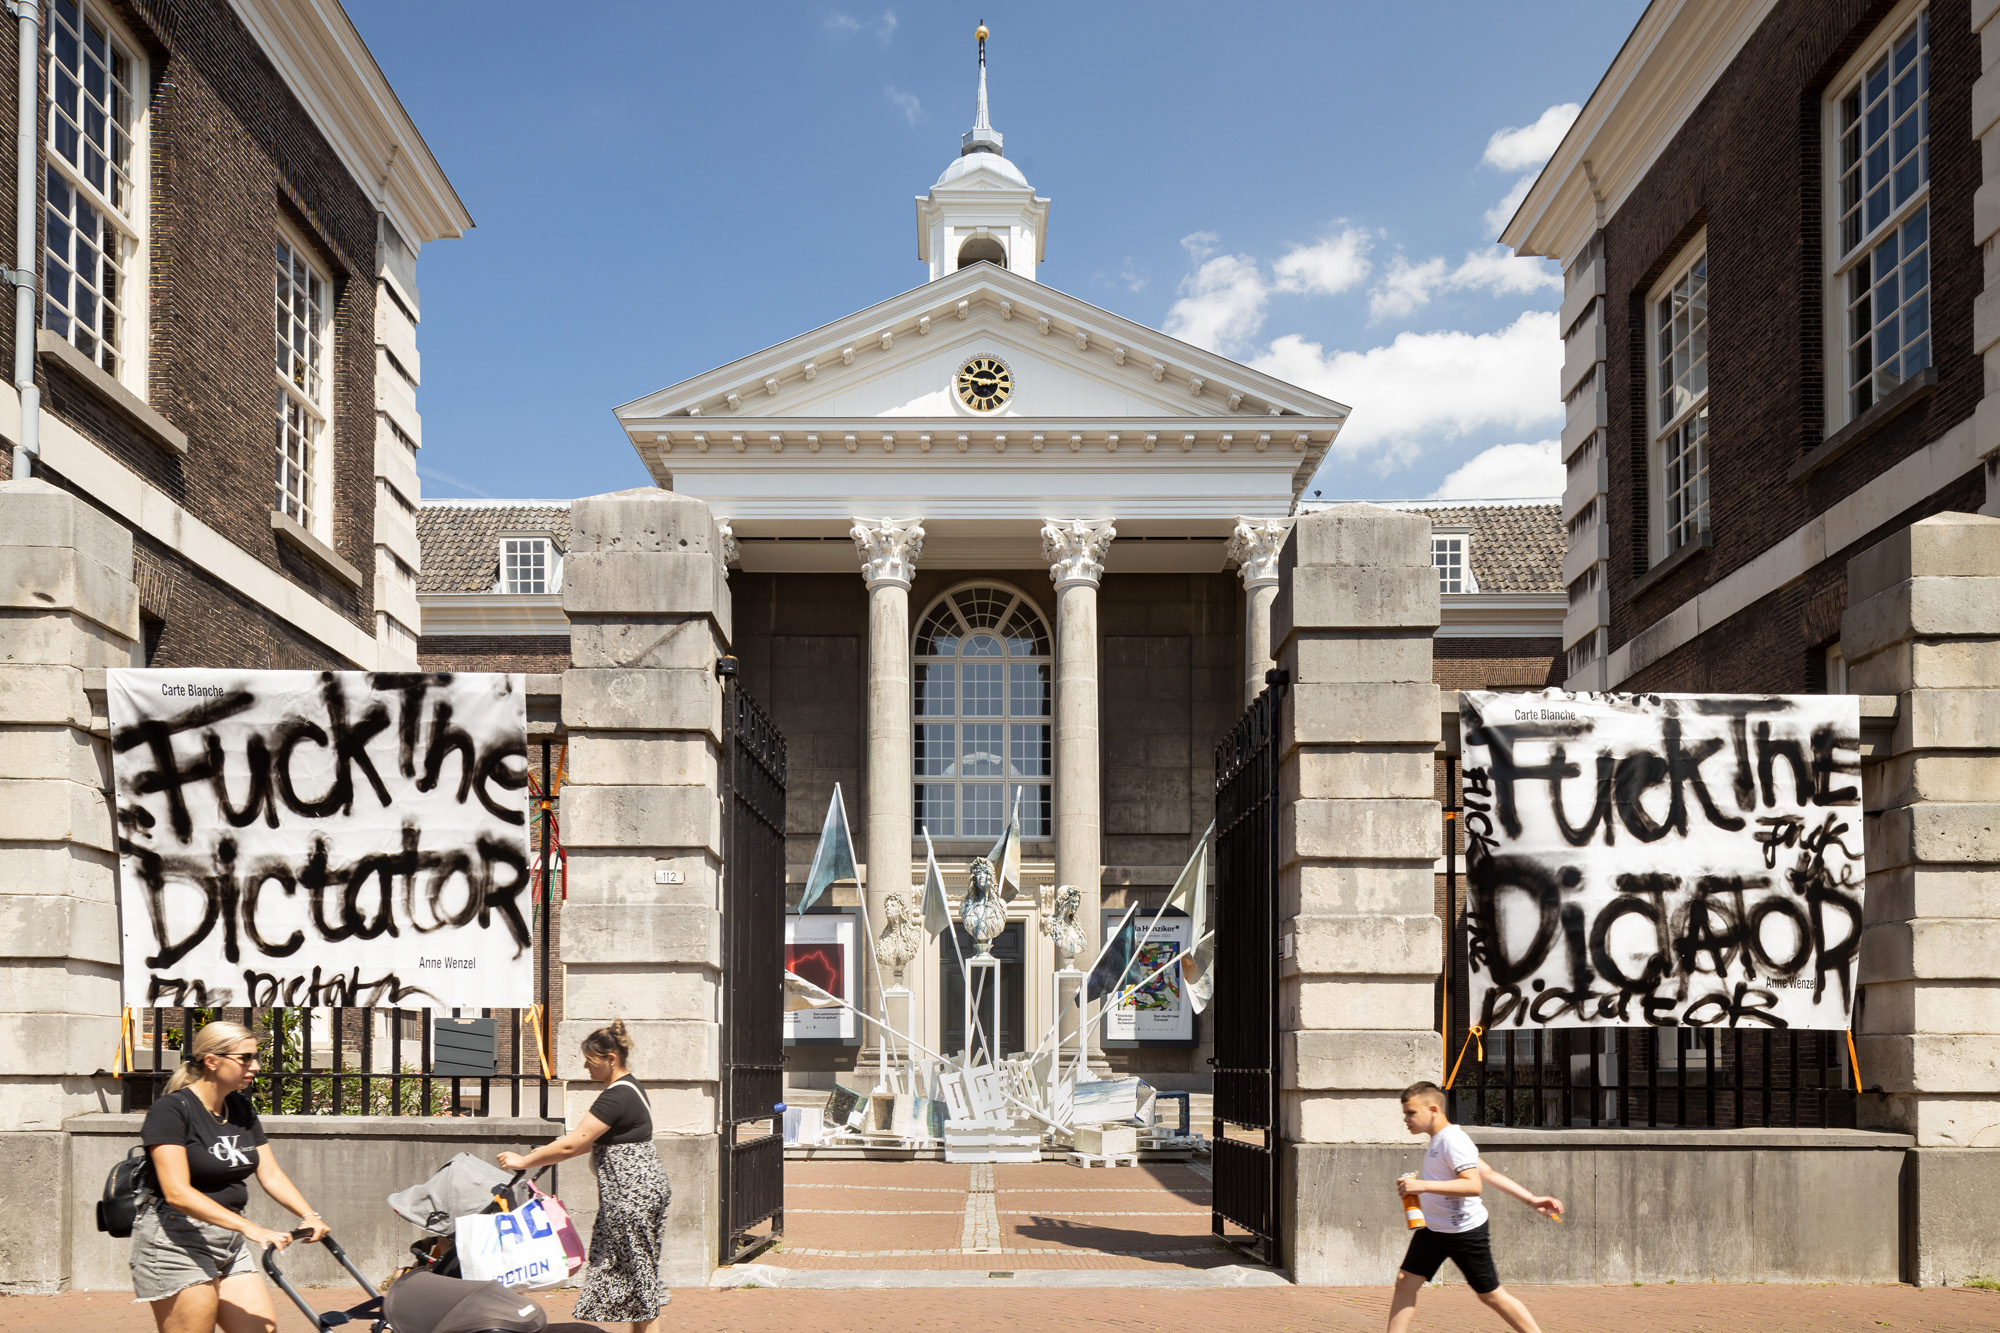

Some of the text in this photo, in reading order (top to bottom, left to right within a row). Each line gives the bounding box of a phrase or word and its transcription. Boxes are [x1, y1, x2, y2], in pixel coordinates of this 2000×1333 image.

[161, 683, 225, 697] Carte Blanche
[1514, 708, 1576, 721] Carte Blanche
[113, 671, 393, 844] Fuck
[1466, 698, 1746, 847] Fuck
[662, 871, 677, 882] 112
[418, 956, 476, 970] Anne Wenzel
[1765, 975, 1817, 990] Anne Wenzel
